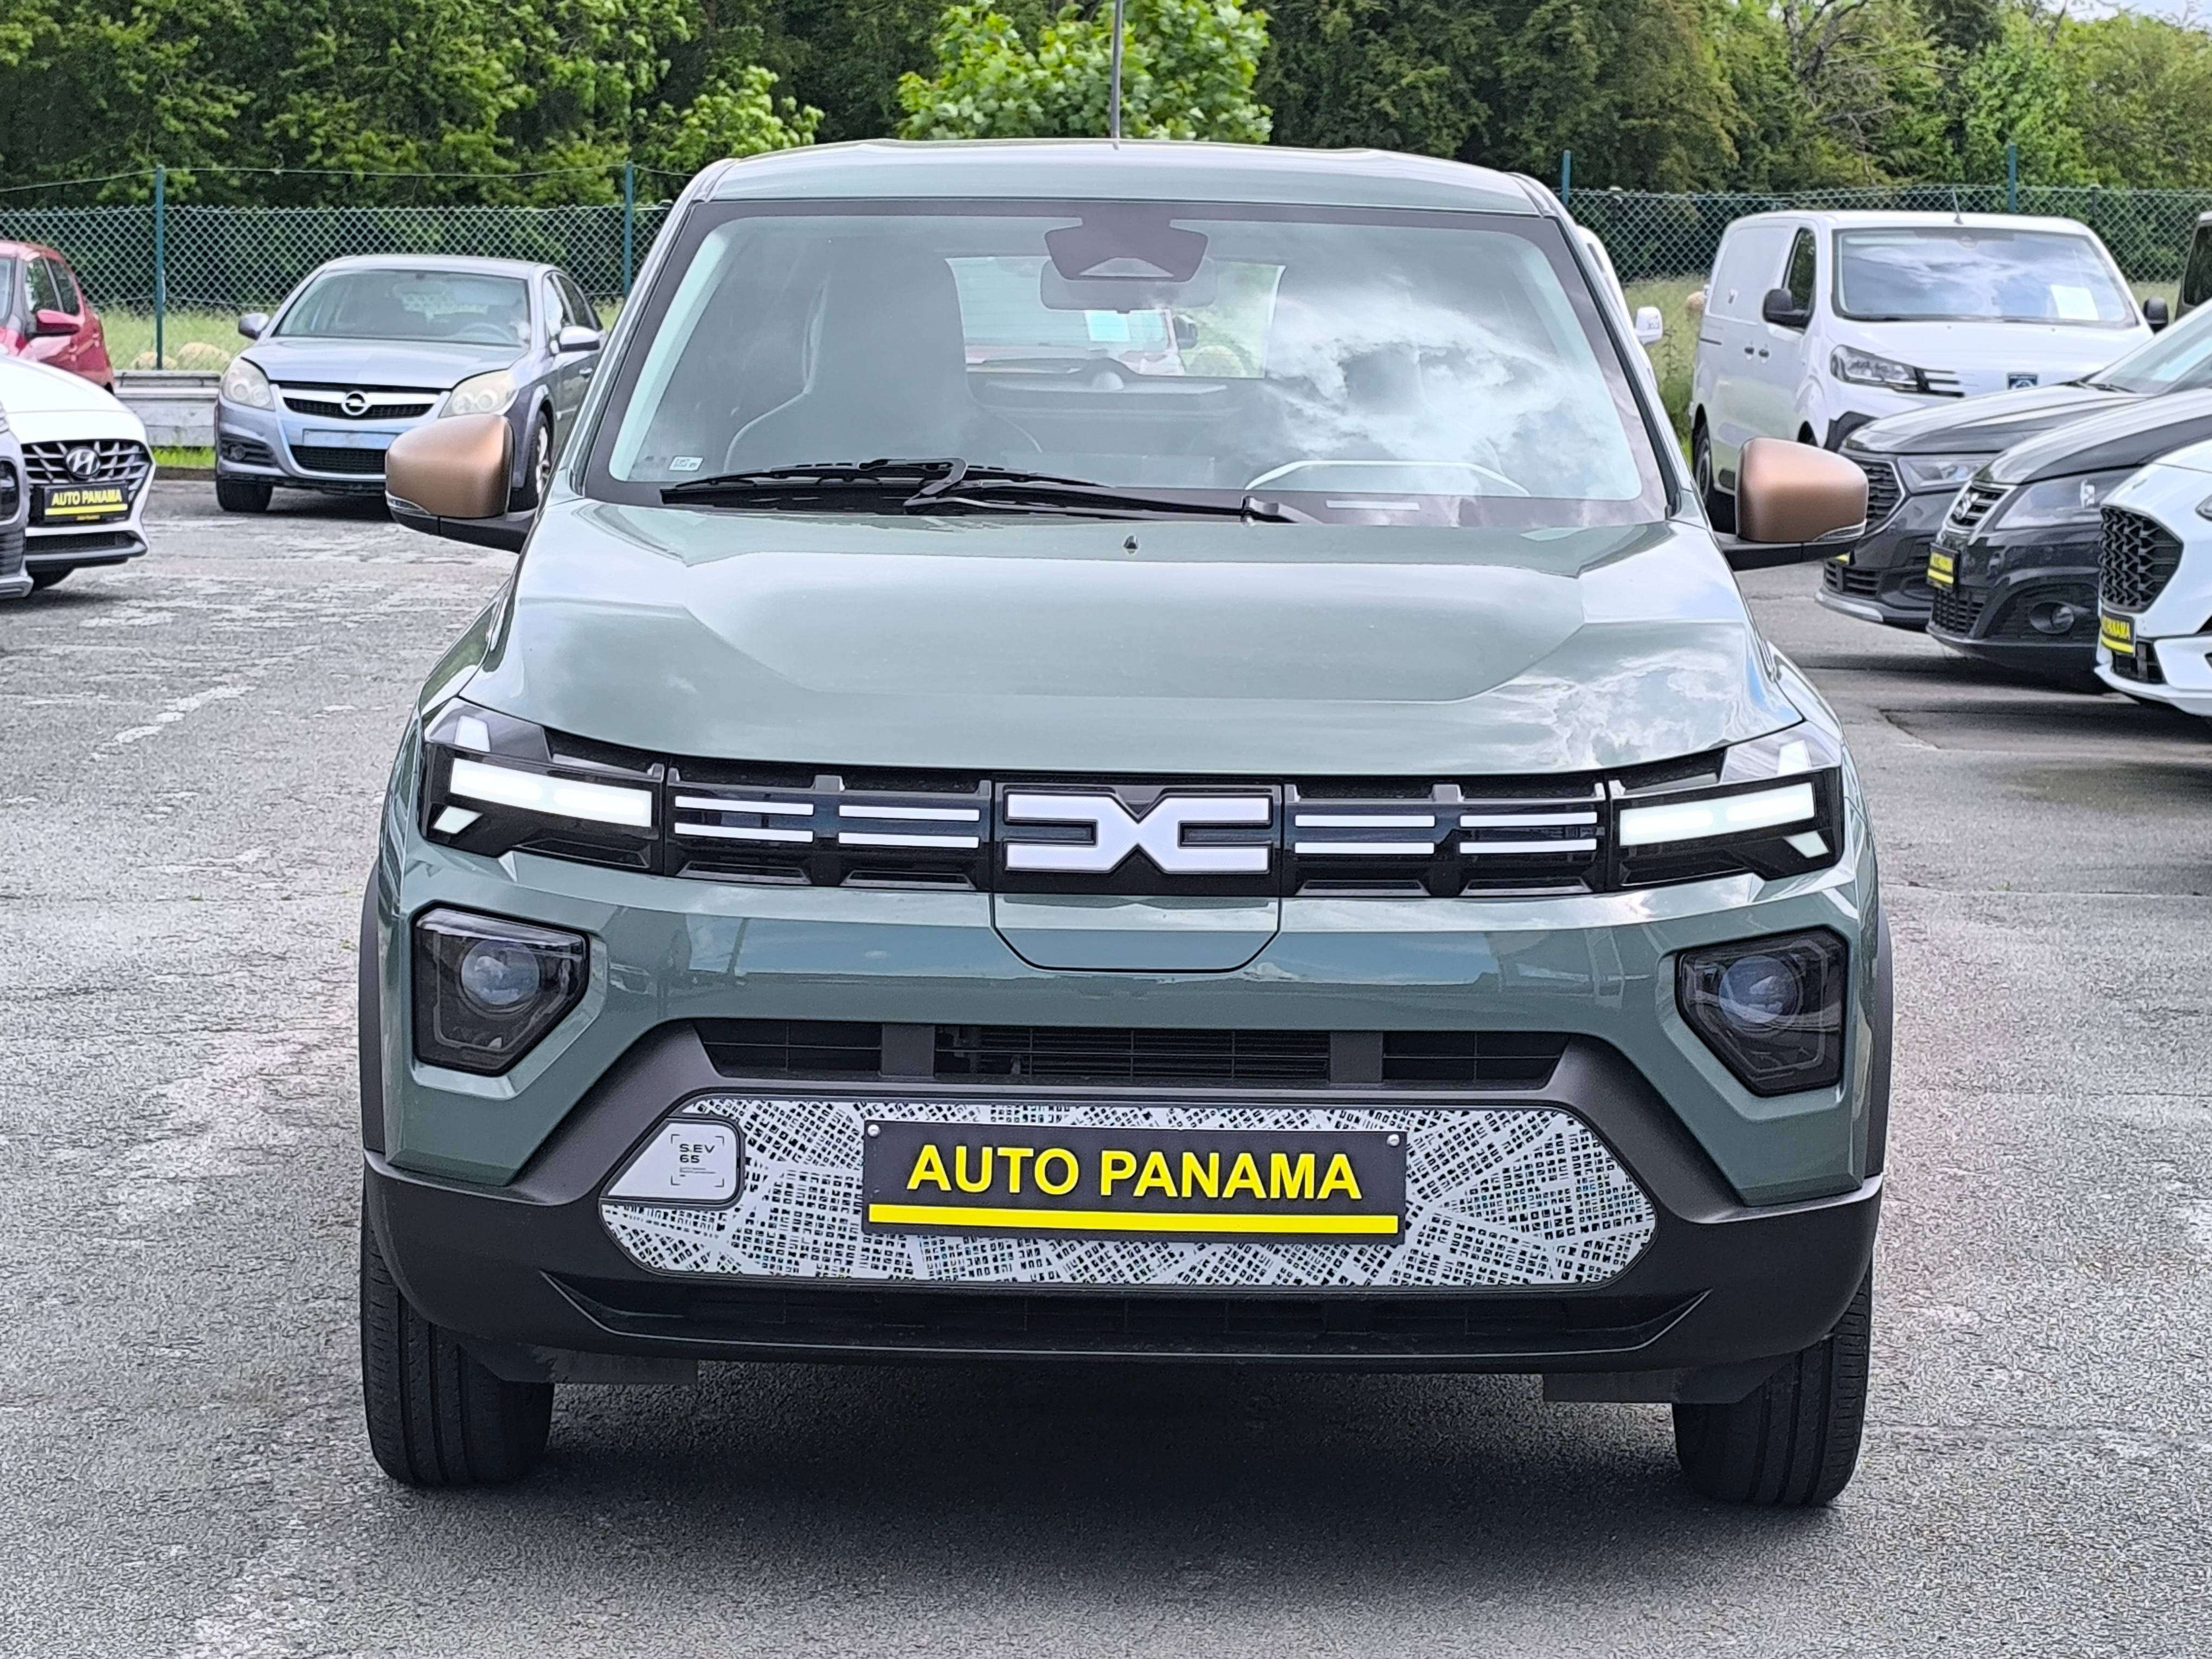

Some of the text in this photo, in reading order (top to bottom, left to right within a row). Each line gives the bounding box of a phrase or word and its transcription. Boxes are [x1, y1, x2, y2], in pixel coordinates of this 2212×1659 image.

[52, 488, 122, 506] AUTO PANAMA
[907, 1145, 1362, 1200] AUTO PANAMA
